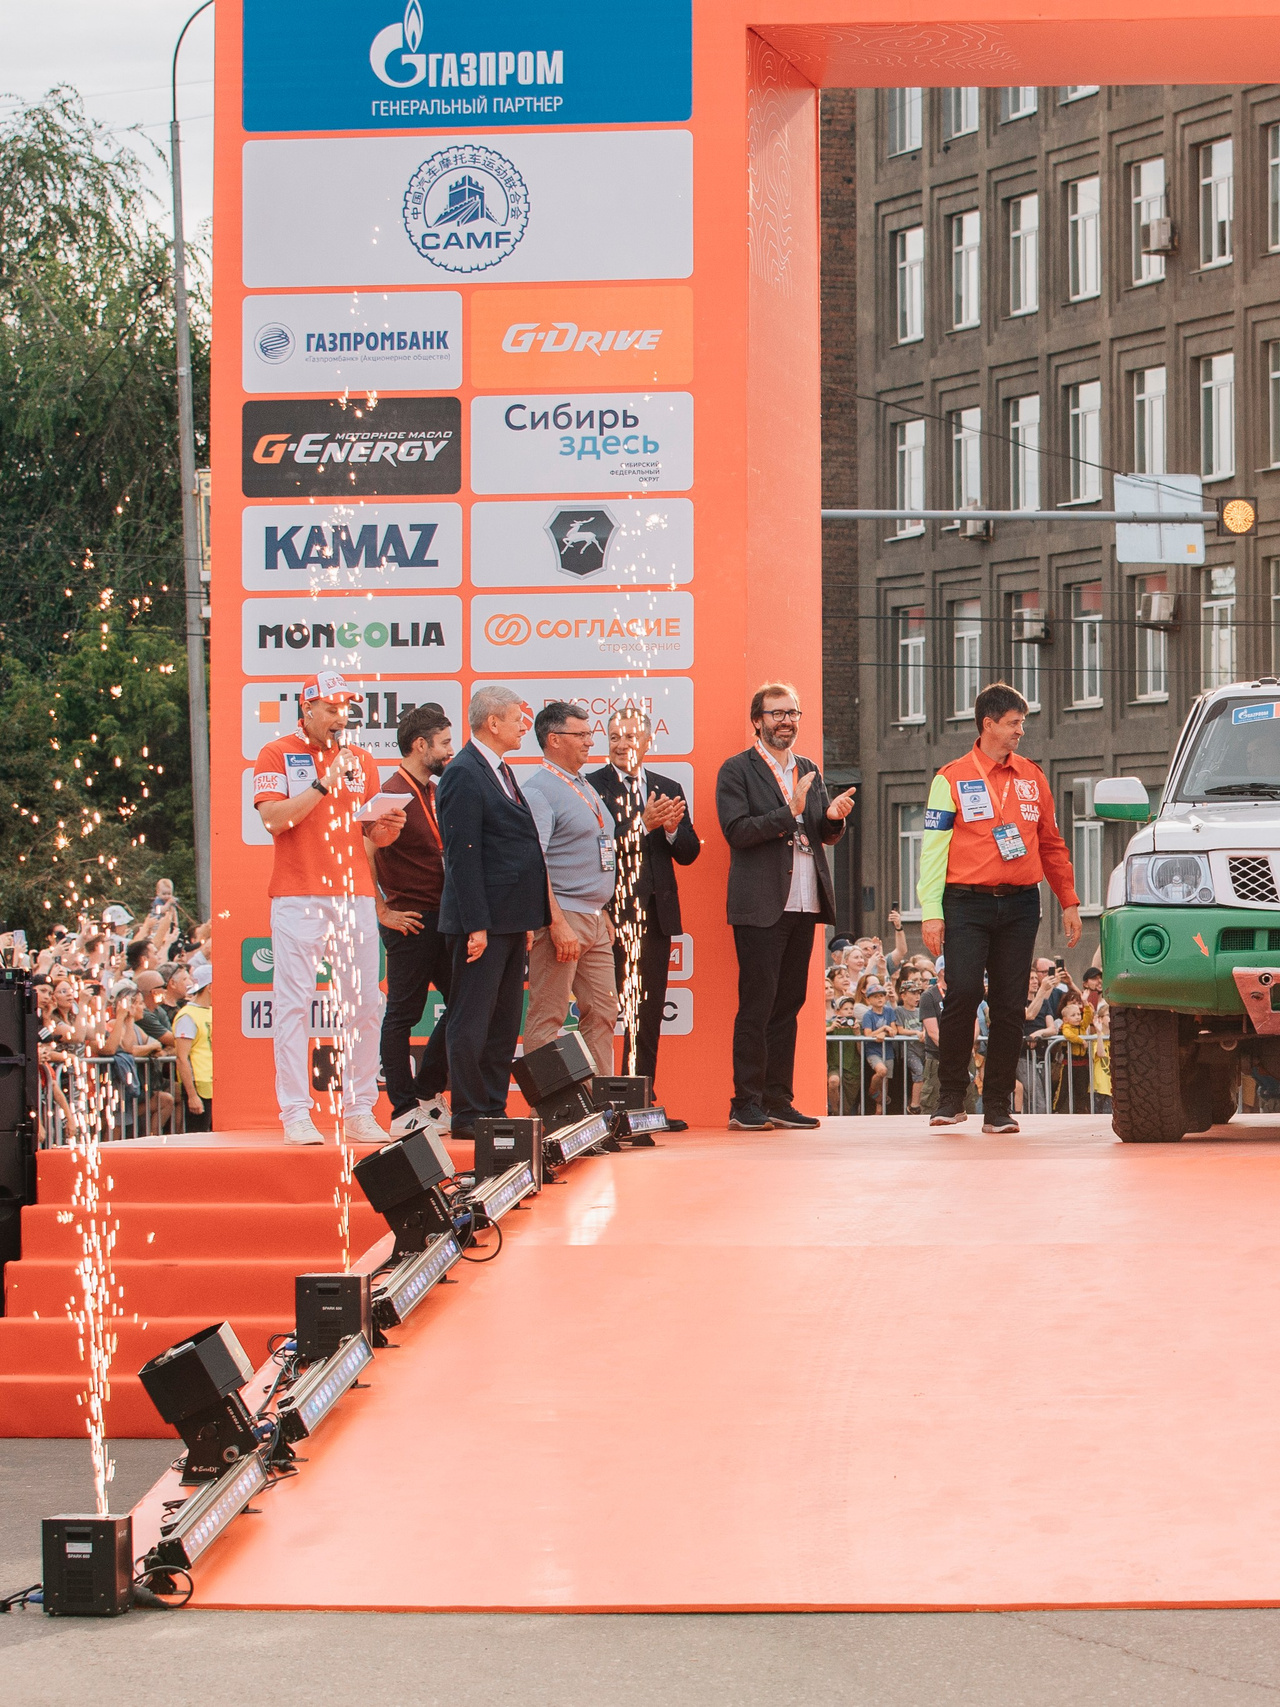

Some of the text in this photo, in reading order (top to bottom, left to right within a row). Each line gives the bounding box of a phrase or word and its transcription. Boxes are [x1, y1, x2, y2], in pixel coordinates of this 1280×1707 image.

[428, 50, 564, 88] ГАЗПРОМ
[371, 95, 564, 117] ГЕНЕРАЛЬНЫЙ ПАРТНЕР
[420, 230, 513, 251] CAMF
[305, 330, 450, 353] ГАЗПРОМБАНК
[504, 403, 640, 436] Сибирь
[408, 430, 454, 440] МАСЛО
[559, 434, 661, 461] здесь
[609, 468, 661, 476] ФЕДЕРАЛЬНЫЙ
[264, 523, 440, 571] KAMAZ
[258, 620, 446, 650] MONGOLIA
[535, 617, 682, 639] СОГЛАСИЕ
[599, 641, 682, 655] страхование
[1020, 803, 1039, 813] SILK
[1021, 812, 1040, 823] WAY
